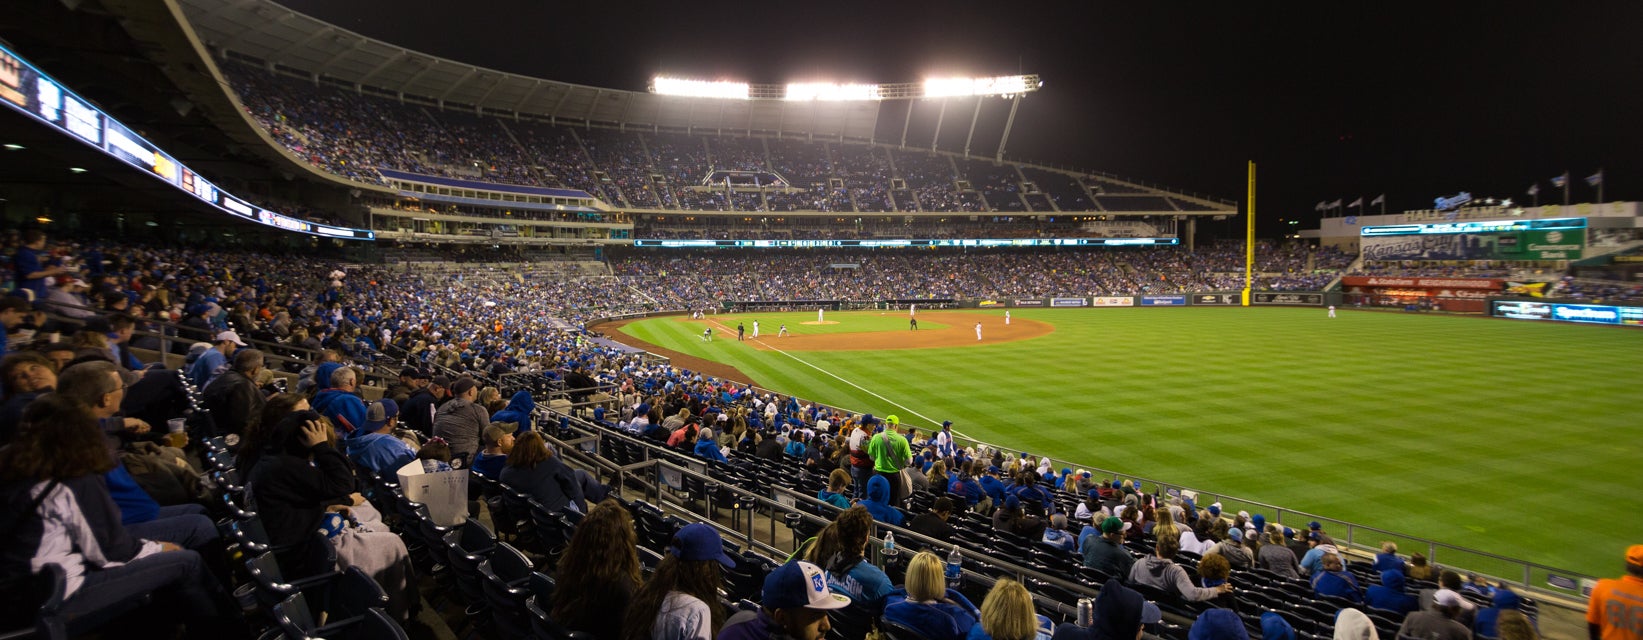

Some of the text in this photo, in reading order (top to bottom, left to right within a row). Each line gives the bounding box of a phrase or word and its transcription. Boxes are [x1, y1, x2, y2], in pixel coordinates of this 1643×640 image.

[1404, 208, 1444, 221] HALL
[1459, 205, 1506, 219] FAME
[1364, 233, 1455, 261] Kansas City
